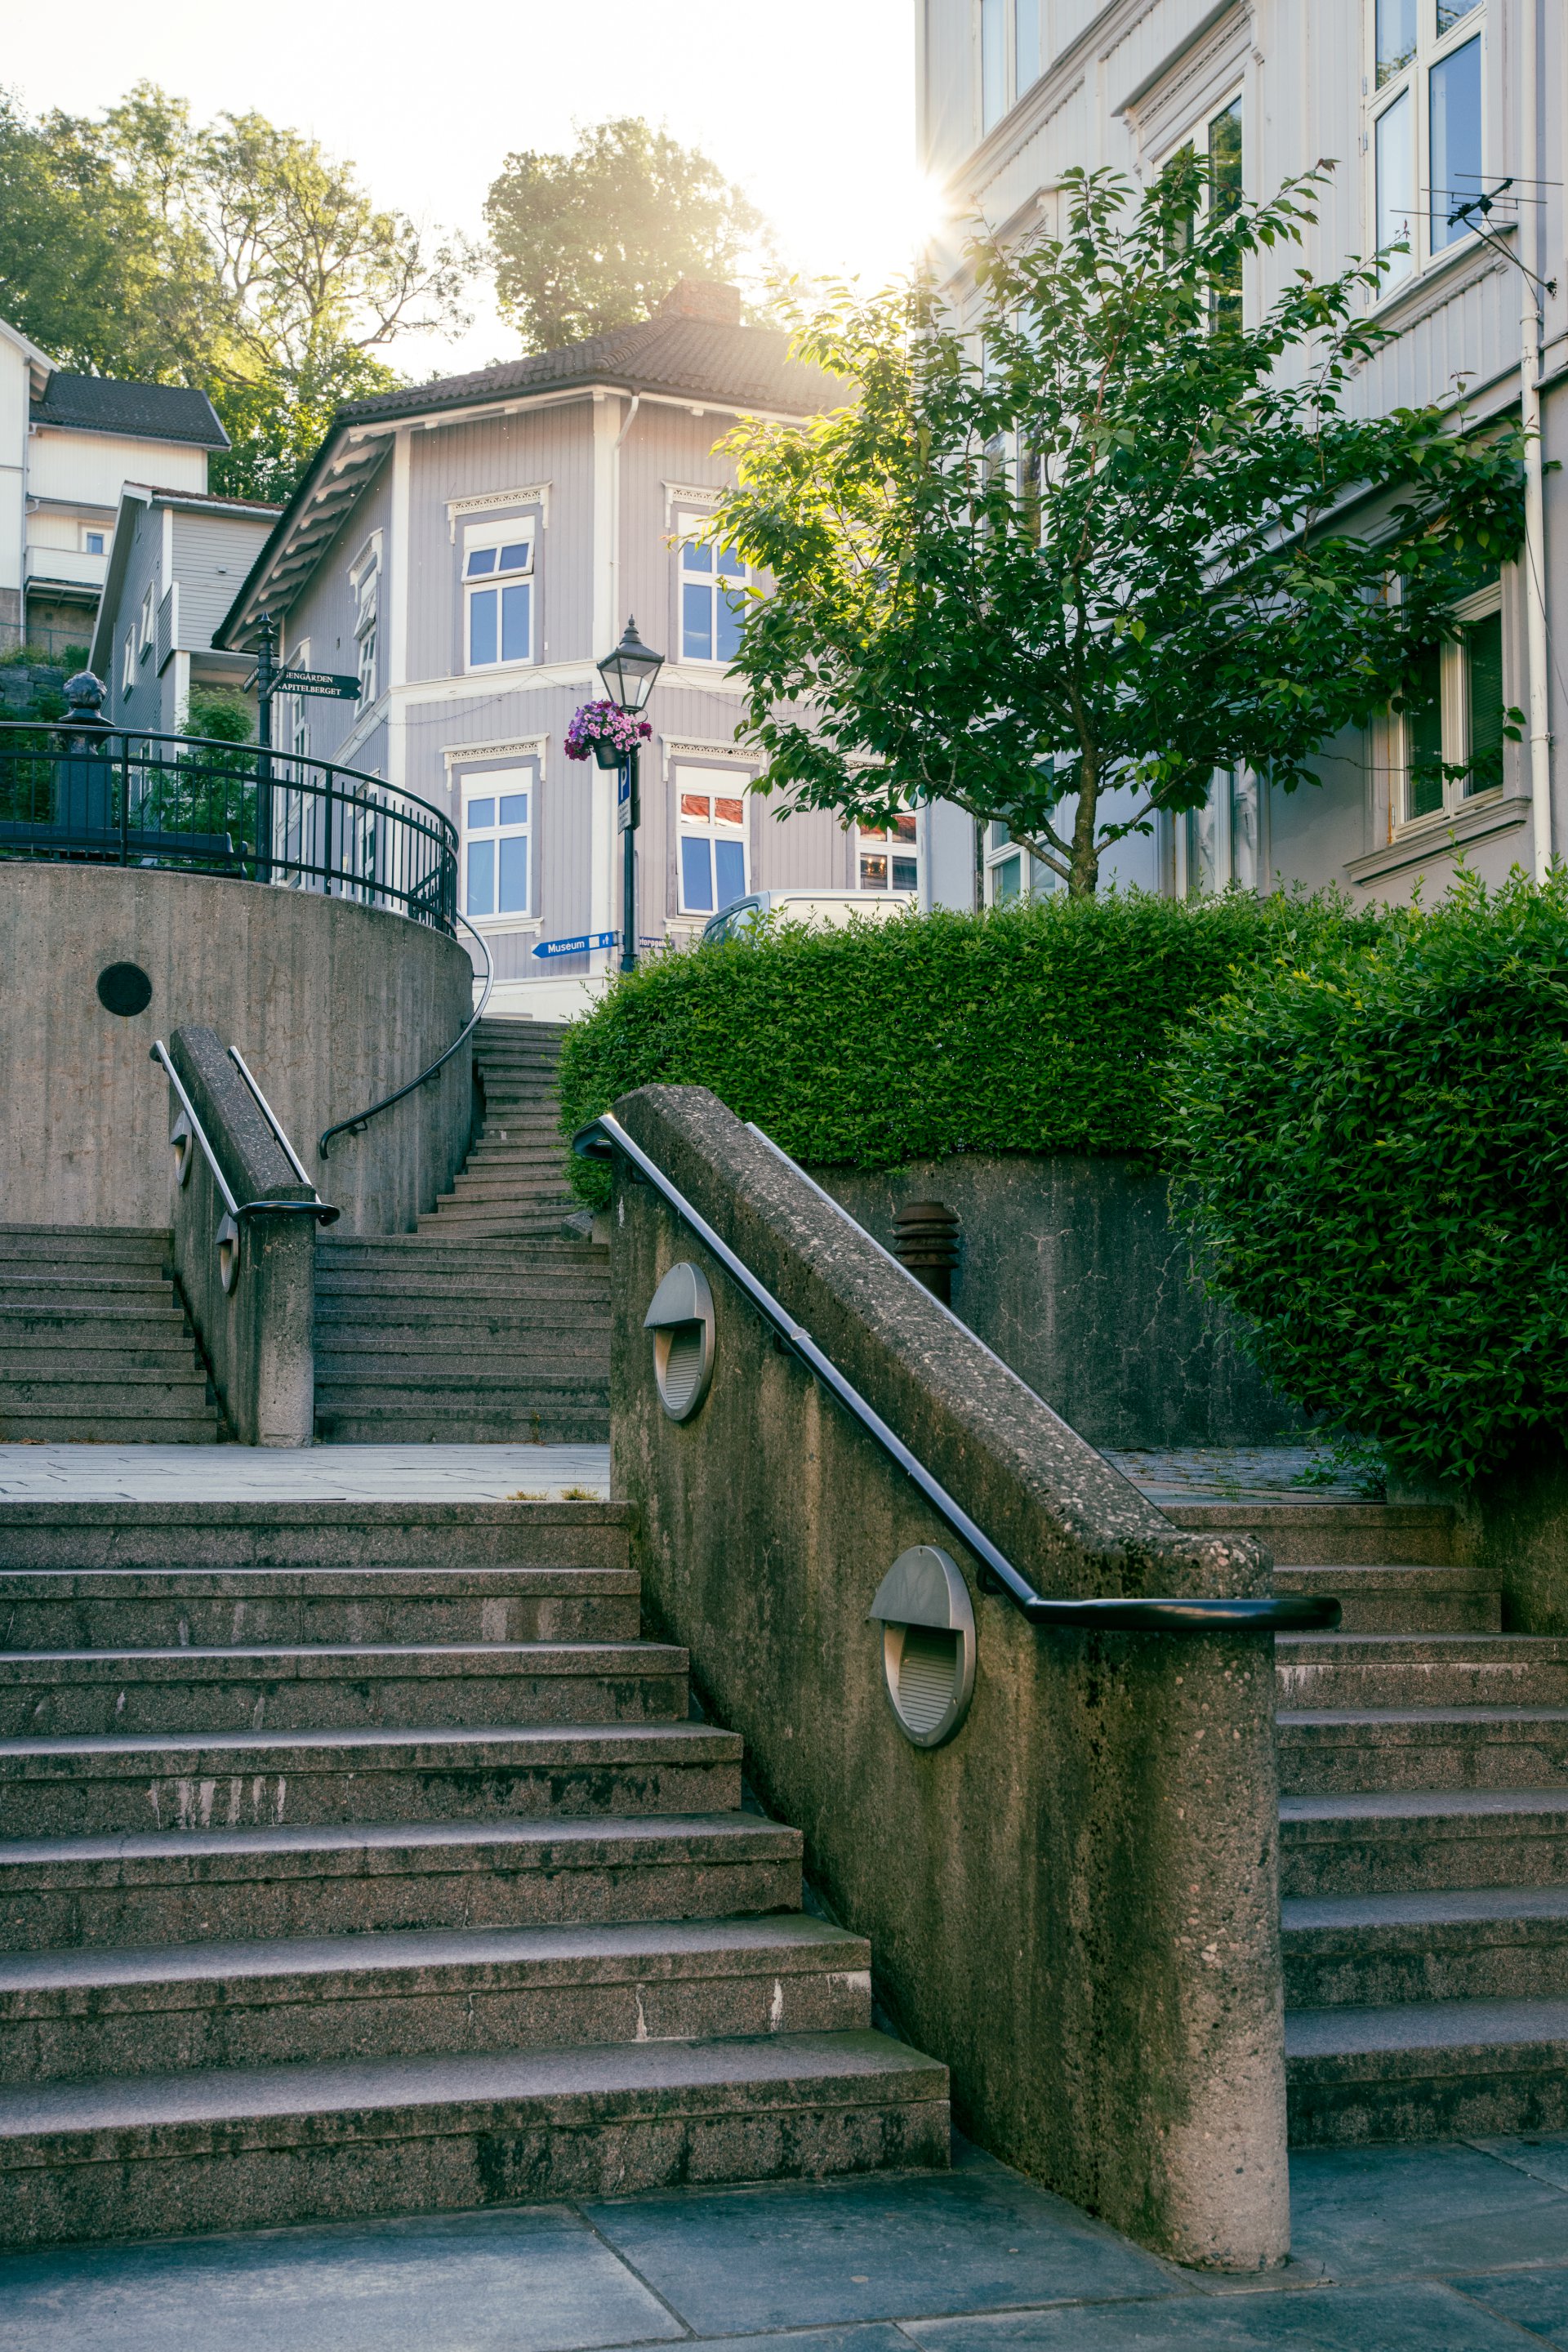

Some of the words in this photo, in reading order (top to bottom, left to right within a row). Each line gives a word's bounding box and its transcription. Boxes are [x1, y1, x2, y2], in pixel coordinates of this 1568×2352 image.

[284, 672, 333, 683] SENGÅRDEN
[278, 683, 341, 696] APITELBERGET
[621, 766, 627, 800] P
[548, 940, 585, 954] Museum
